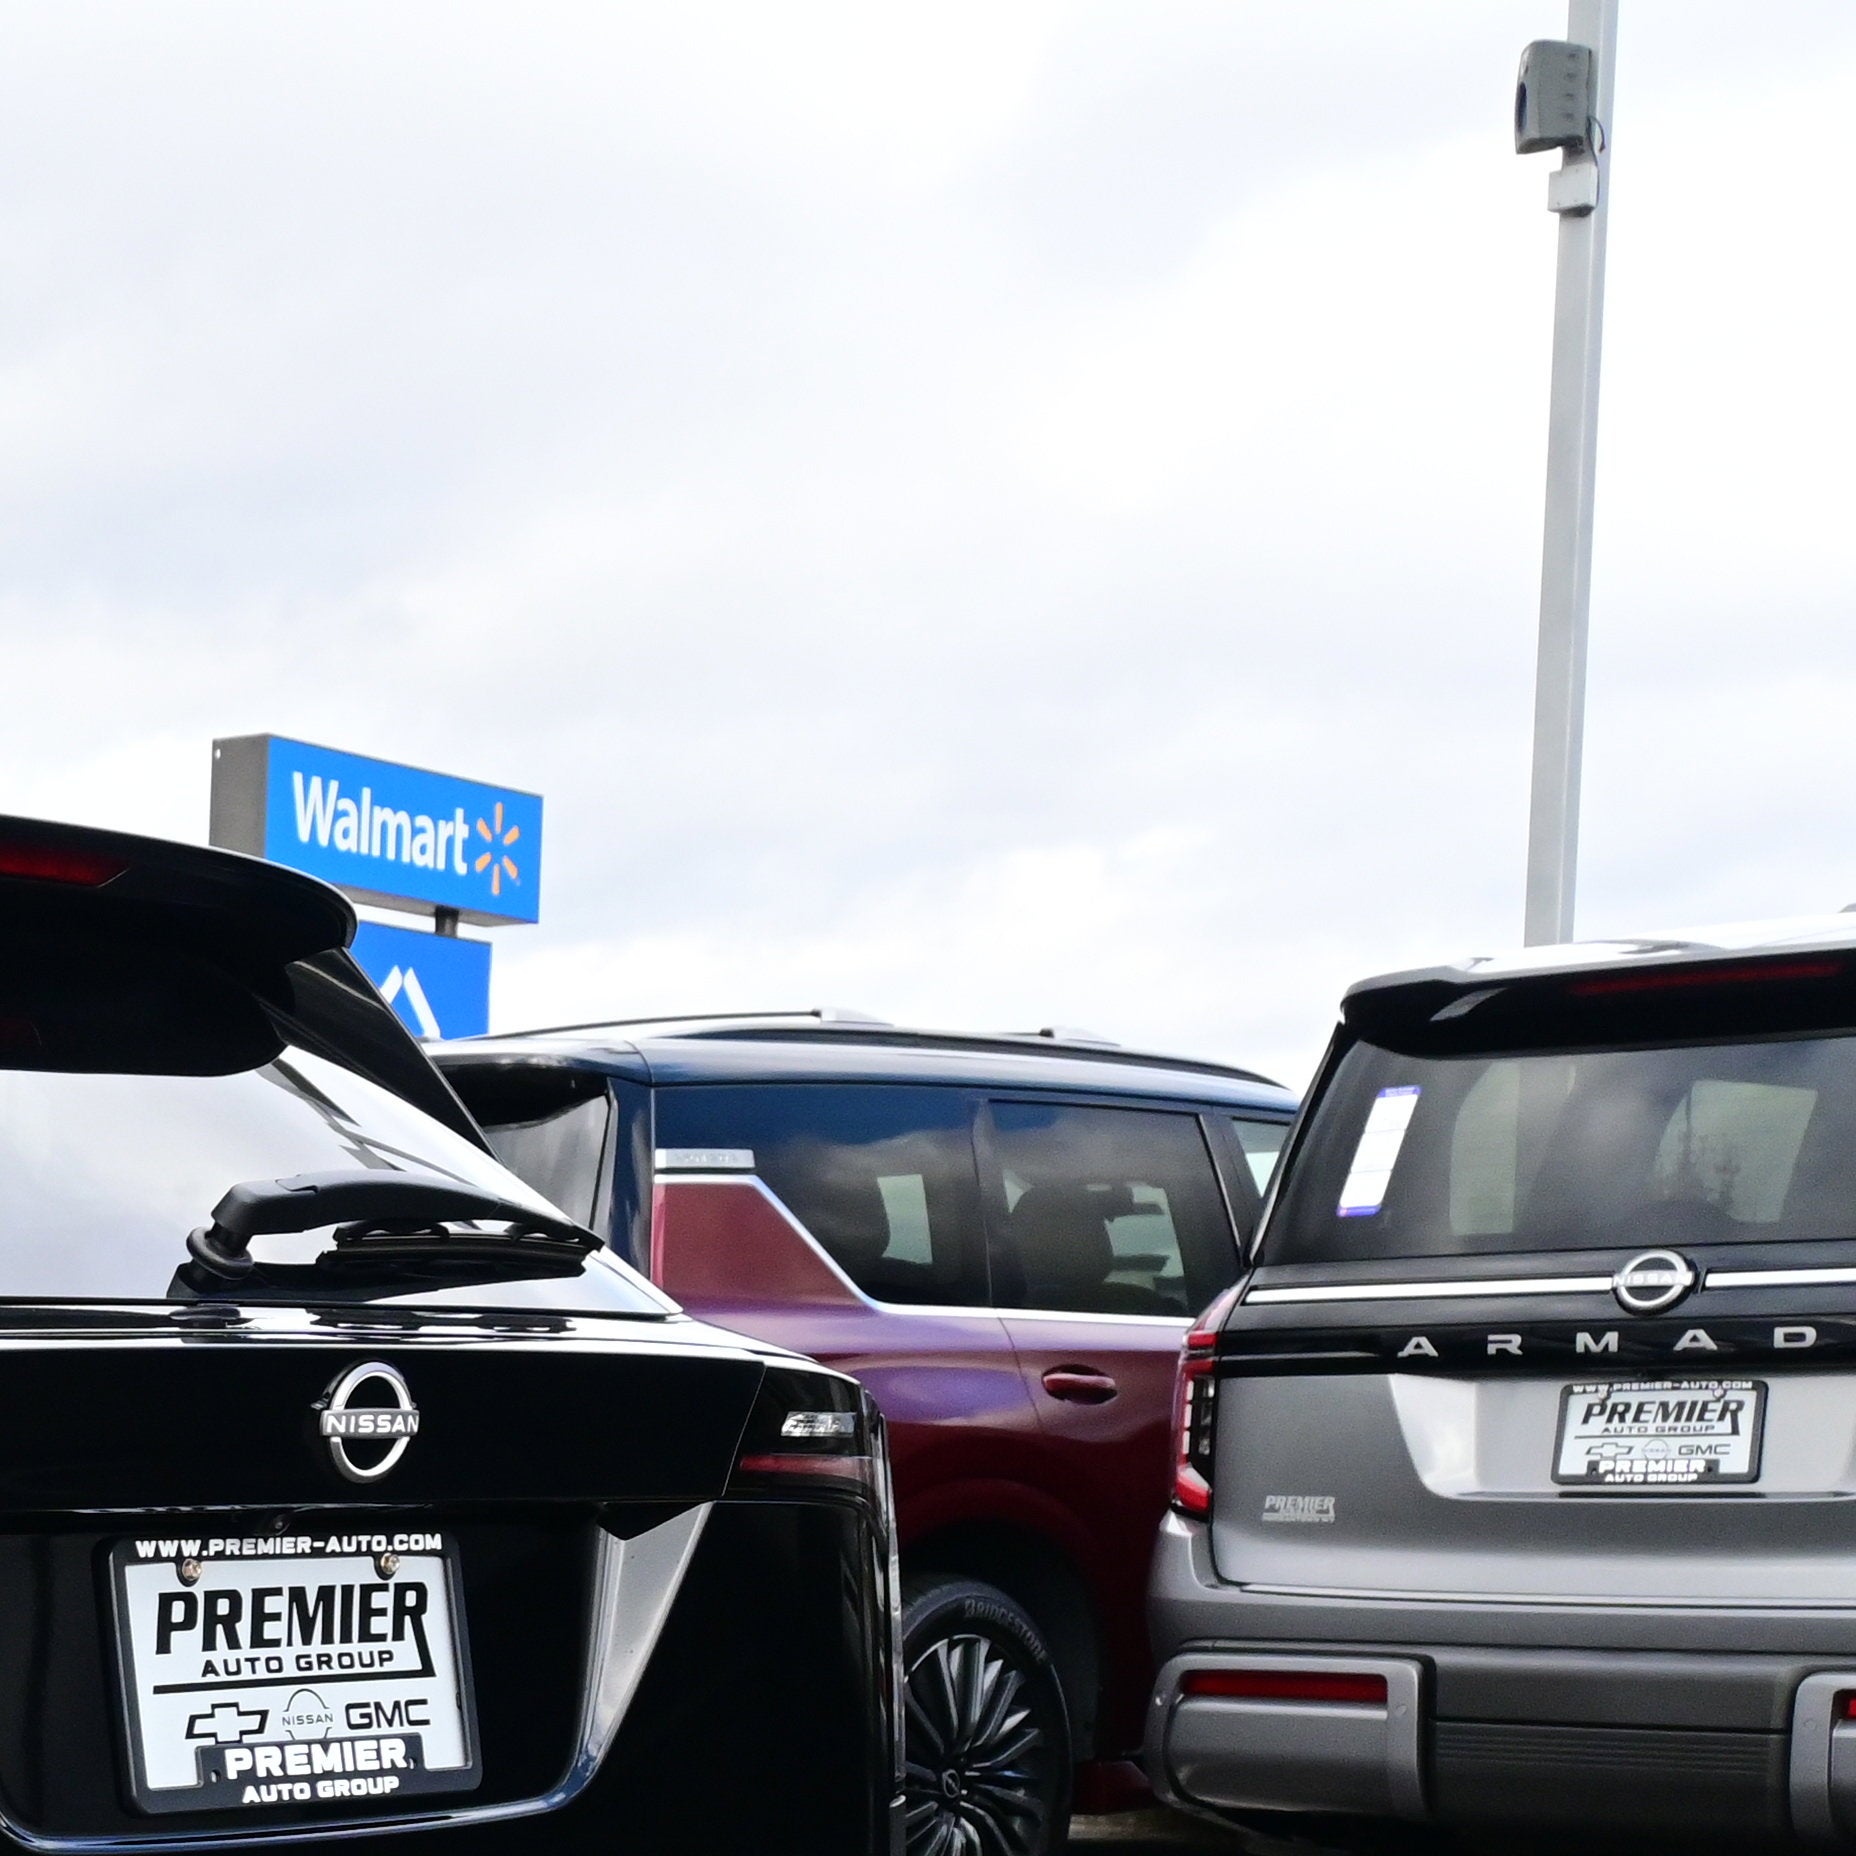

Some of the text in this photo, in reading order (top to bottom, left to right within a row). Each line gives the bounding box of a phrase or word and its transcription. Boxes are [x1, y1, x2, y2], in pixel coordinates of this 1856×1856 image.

[292, 771, 469, 876] Walmart
[1572, 1381, 1753, 1393] WWW.PREMIER-AUTO.COM
[326, 1413, 420, 1434] NISSAN
[1581, 1400, 1745, 1425] PREMIER
[1601, 1424, 1715, 1434] AUTO GROUP
[1678, 1444, 1731, 1456] GMC
[1598, 1459, 1706, 1474] PREMIER
[1604, 1473, 1698, 1483] AUTO GROUP
[1264, 1495, 1335, 1513] PREMIER
[136, 1534, 442, 1558] WWW.PREMIER-AUTO.COM
[155, 1581, 432, 1661] PREMIER
[201, 1649, 395, 1678] AUTO GROUP
[282, 1698, 431, 1730] NISSAN GMC
[225, 1738, 408, 1780] PREMIER
[242, 1776, 400, 1804] AUTO GROUP
